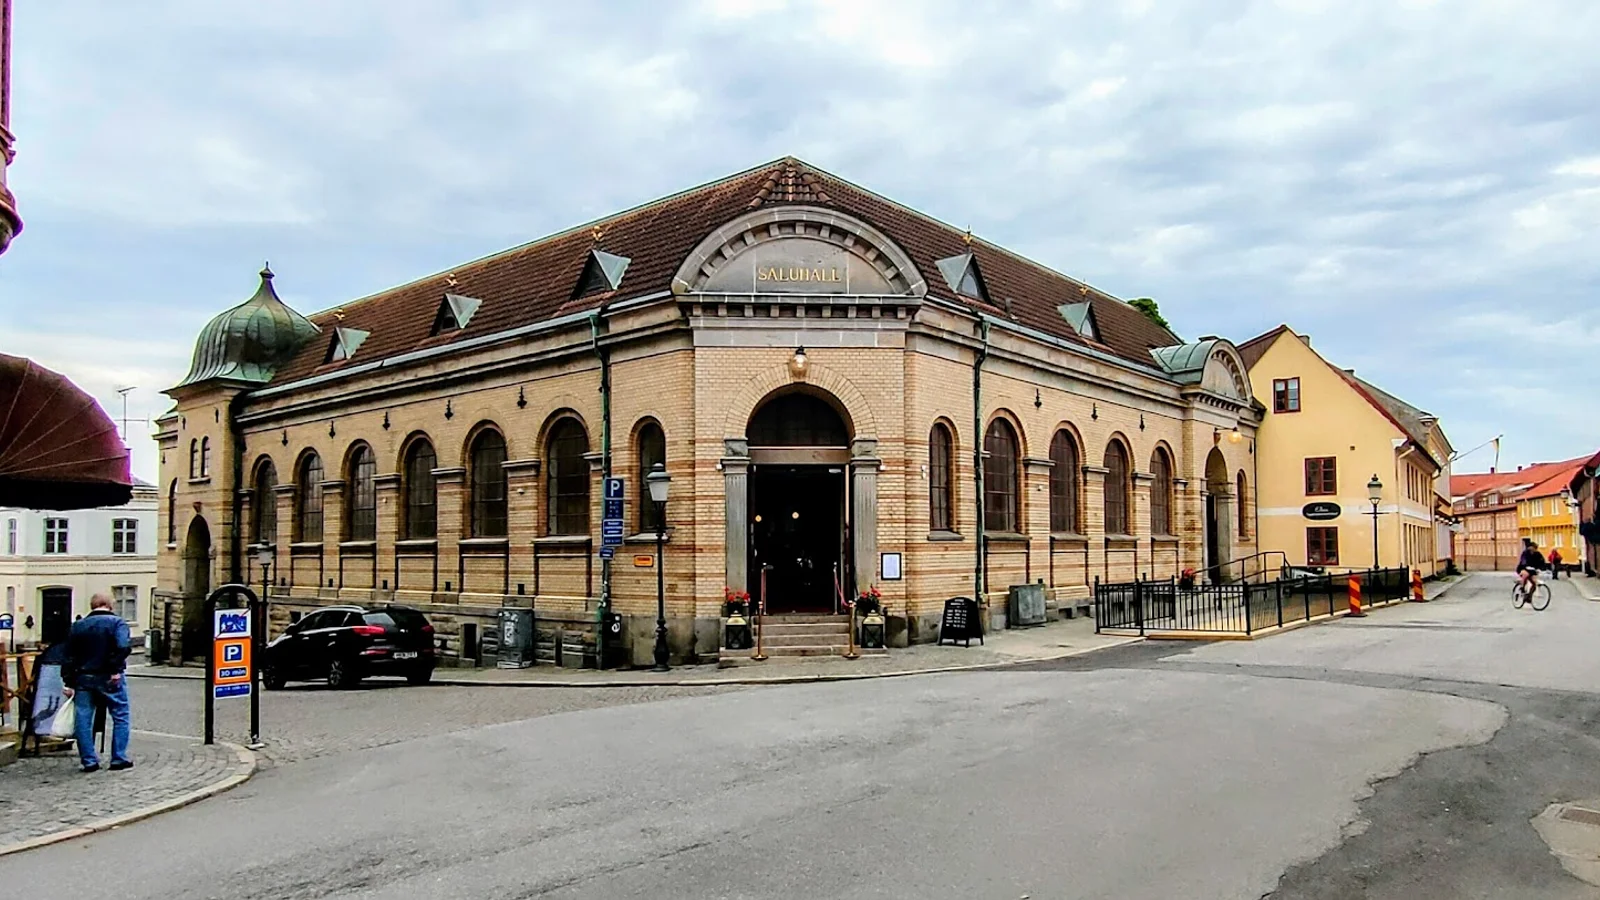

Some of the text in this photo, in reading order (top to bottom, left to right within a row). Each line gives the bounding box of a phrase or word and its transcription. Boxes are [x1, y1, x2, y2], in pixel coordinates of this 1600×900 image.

[758, 267, 841, 282] SALUHALL
[610, 480, 621, 497] P
[226, 646, 239, 660] P
[232, 668, 246, 676] min
